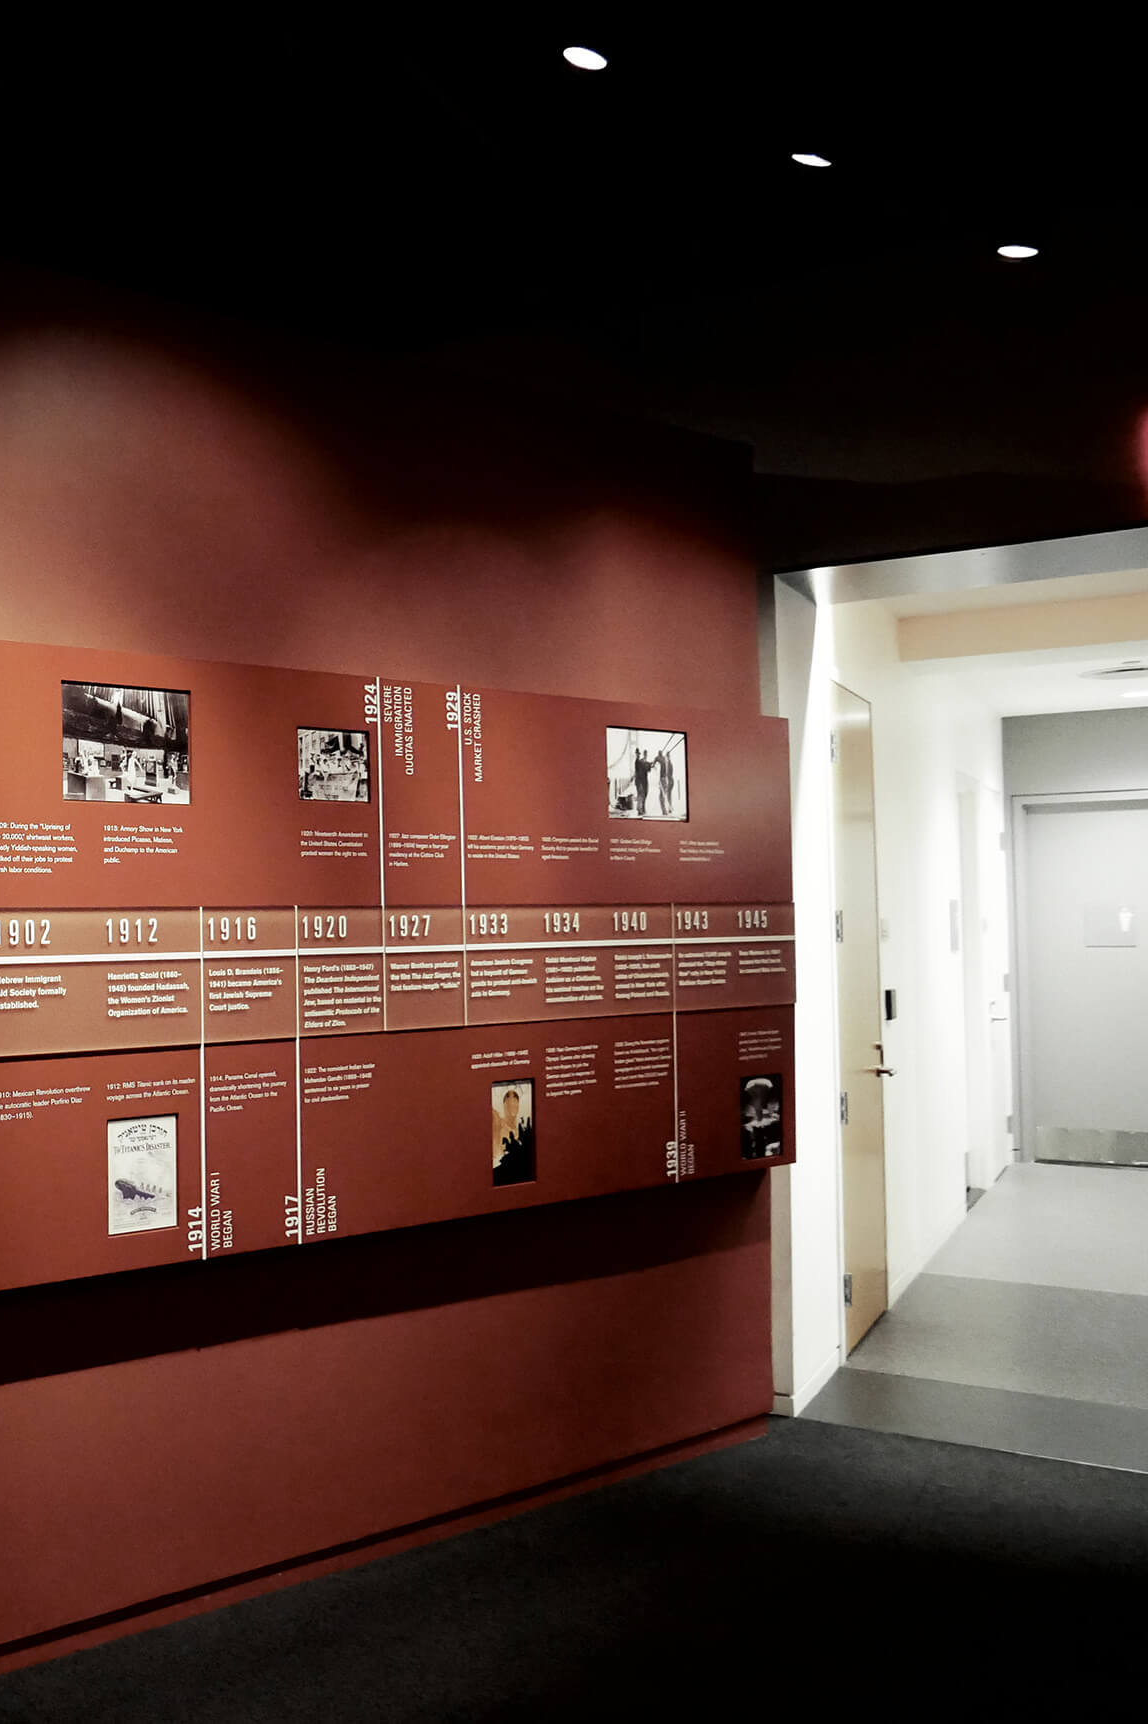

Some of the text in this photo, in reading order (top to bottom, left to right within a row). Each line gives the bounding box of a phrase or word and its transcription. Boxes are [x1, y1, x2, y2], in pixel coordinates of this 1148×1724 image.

[364, 683, 376, 724] 1924
[384, 684, 393, 723] SEVERE
[446, 691, 458, 731] 1929
[464, 692, 472, 746] U.S. STOCK
[394, 686, 403, 758] IMMIGRATION
[404, 687, 413, 776] QUOTAS ENACTED
[472, 693, 483, 782] MARKET CRASHED
[106, 918, 158, 944] 1912
[208, 916, 256, 941] 1916
[302, 916, 348, 938] 1920
[389, 914, 431, 937] 1927
[470, 913, 508, 935] 1933
[544, 912, 580, 932] 1934
[614, 912, 647, 932] 1940
[676, 912, 708, 930] 1943
[738, 910, 768, 929] 1945
[9, 988, 36, 997] Society
[37, 986, 66, 996] formally
[24, 974, 61, 984] Immigrant
[107, 1005, 188, 1017] Organization of America.
[666, 1141, 676, 1176] 1939
[210, 1178, 220, 1206] WAR
[316, 1168, 325, 1234] REVOLUTION
[188, 1206, 202, 1252] 1914
[210, 1208, 220, 1250] WORLD
[223, 1210, 232, 1248] BEGAN
[284, 1195, 298, 1237] 1917
[306, 1188, 314, 1236] RUSSIAN
[328, 1196, 336, 1232] BEGAN
